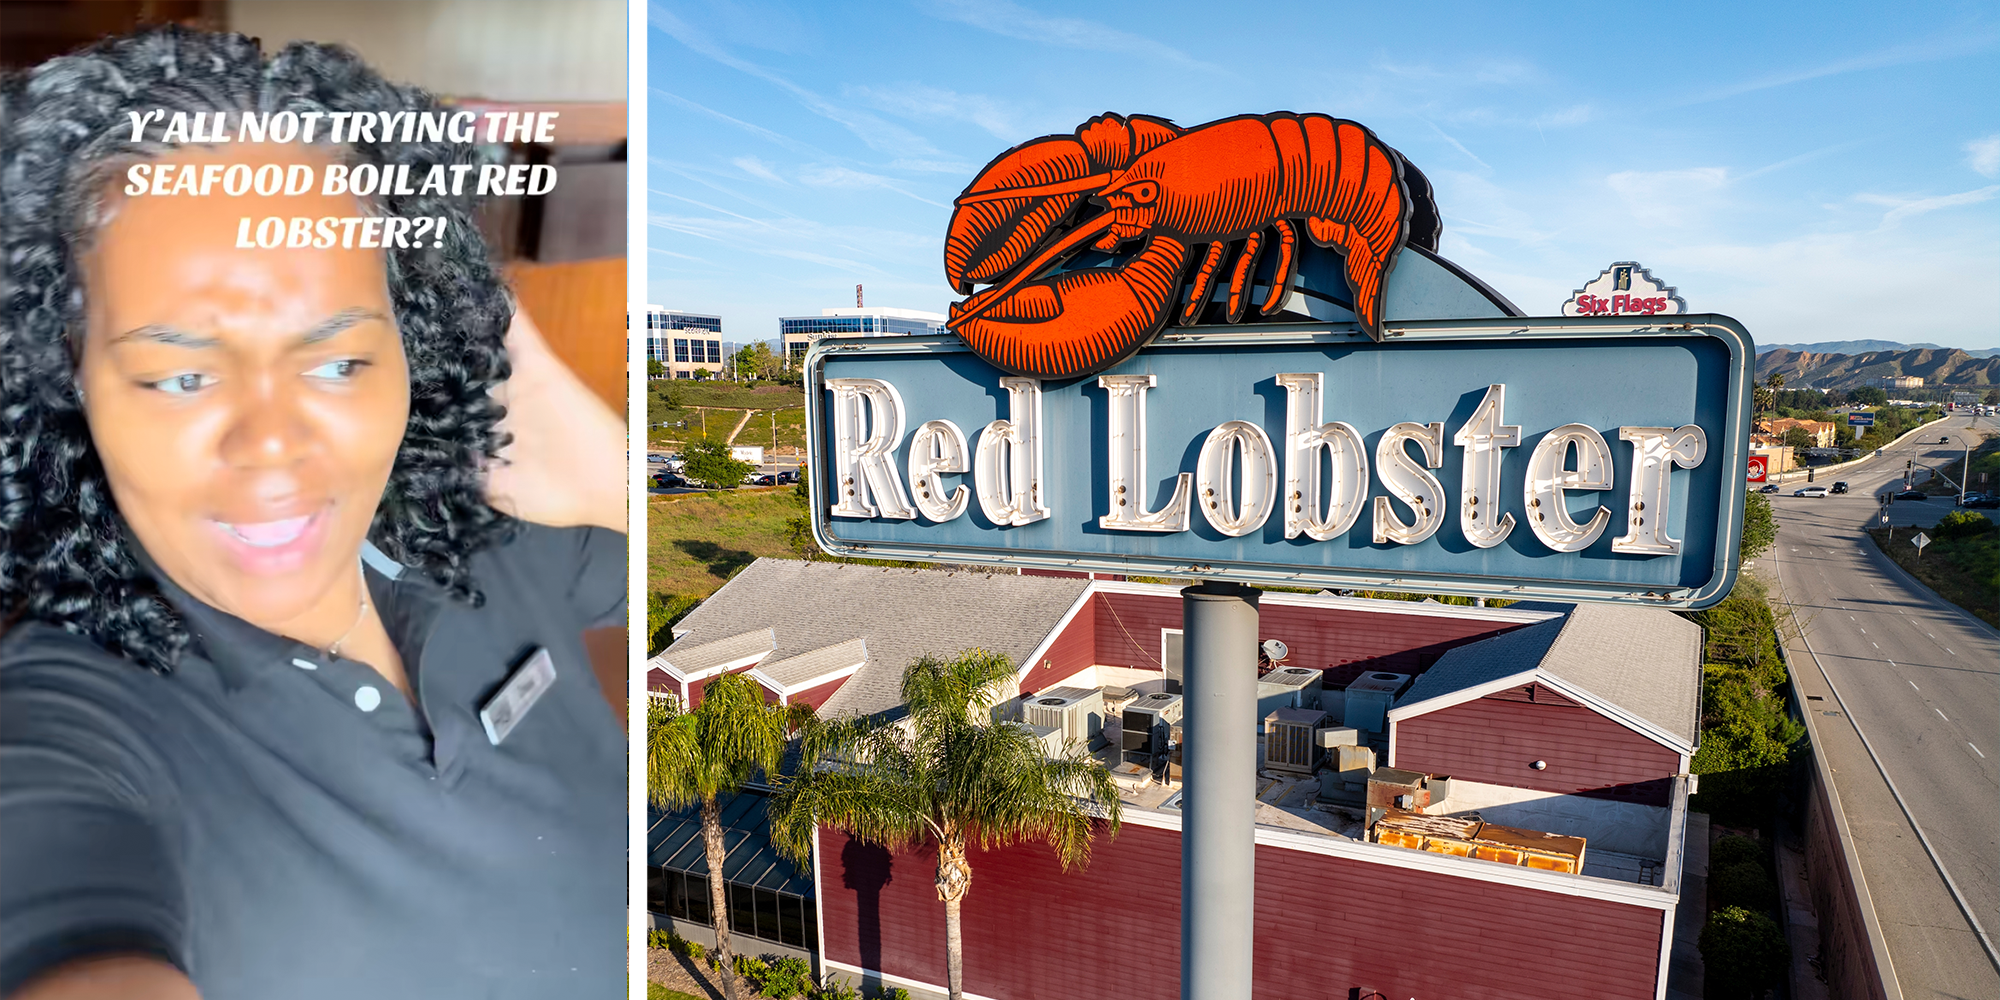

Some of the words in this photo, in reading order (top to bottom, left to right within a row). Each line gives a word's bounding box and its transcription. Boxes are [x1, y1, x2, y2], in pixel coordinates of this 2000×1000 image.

[1576, 294, 1609, 313] Six
[1611, 294, 1667, 315] Flags
[825, 376, 1051, 527] Red
[1098, 372, 1708, 556] Lobster
